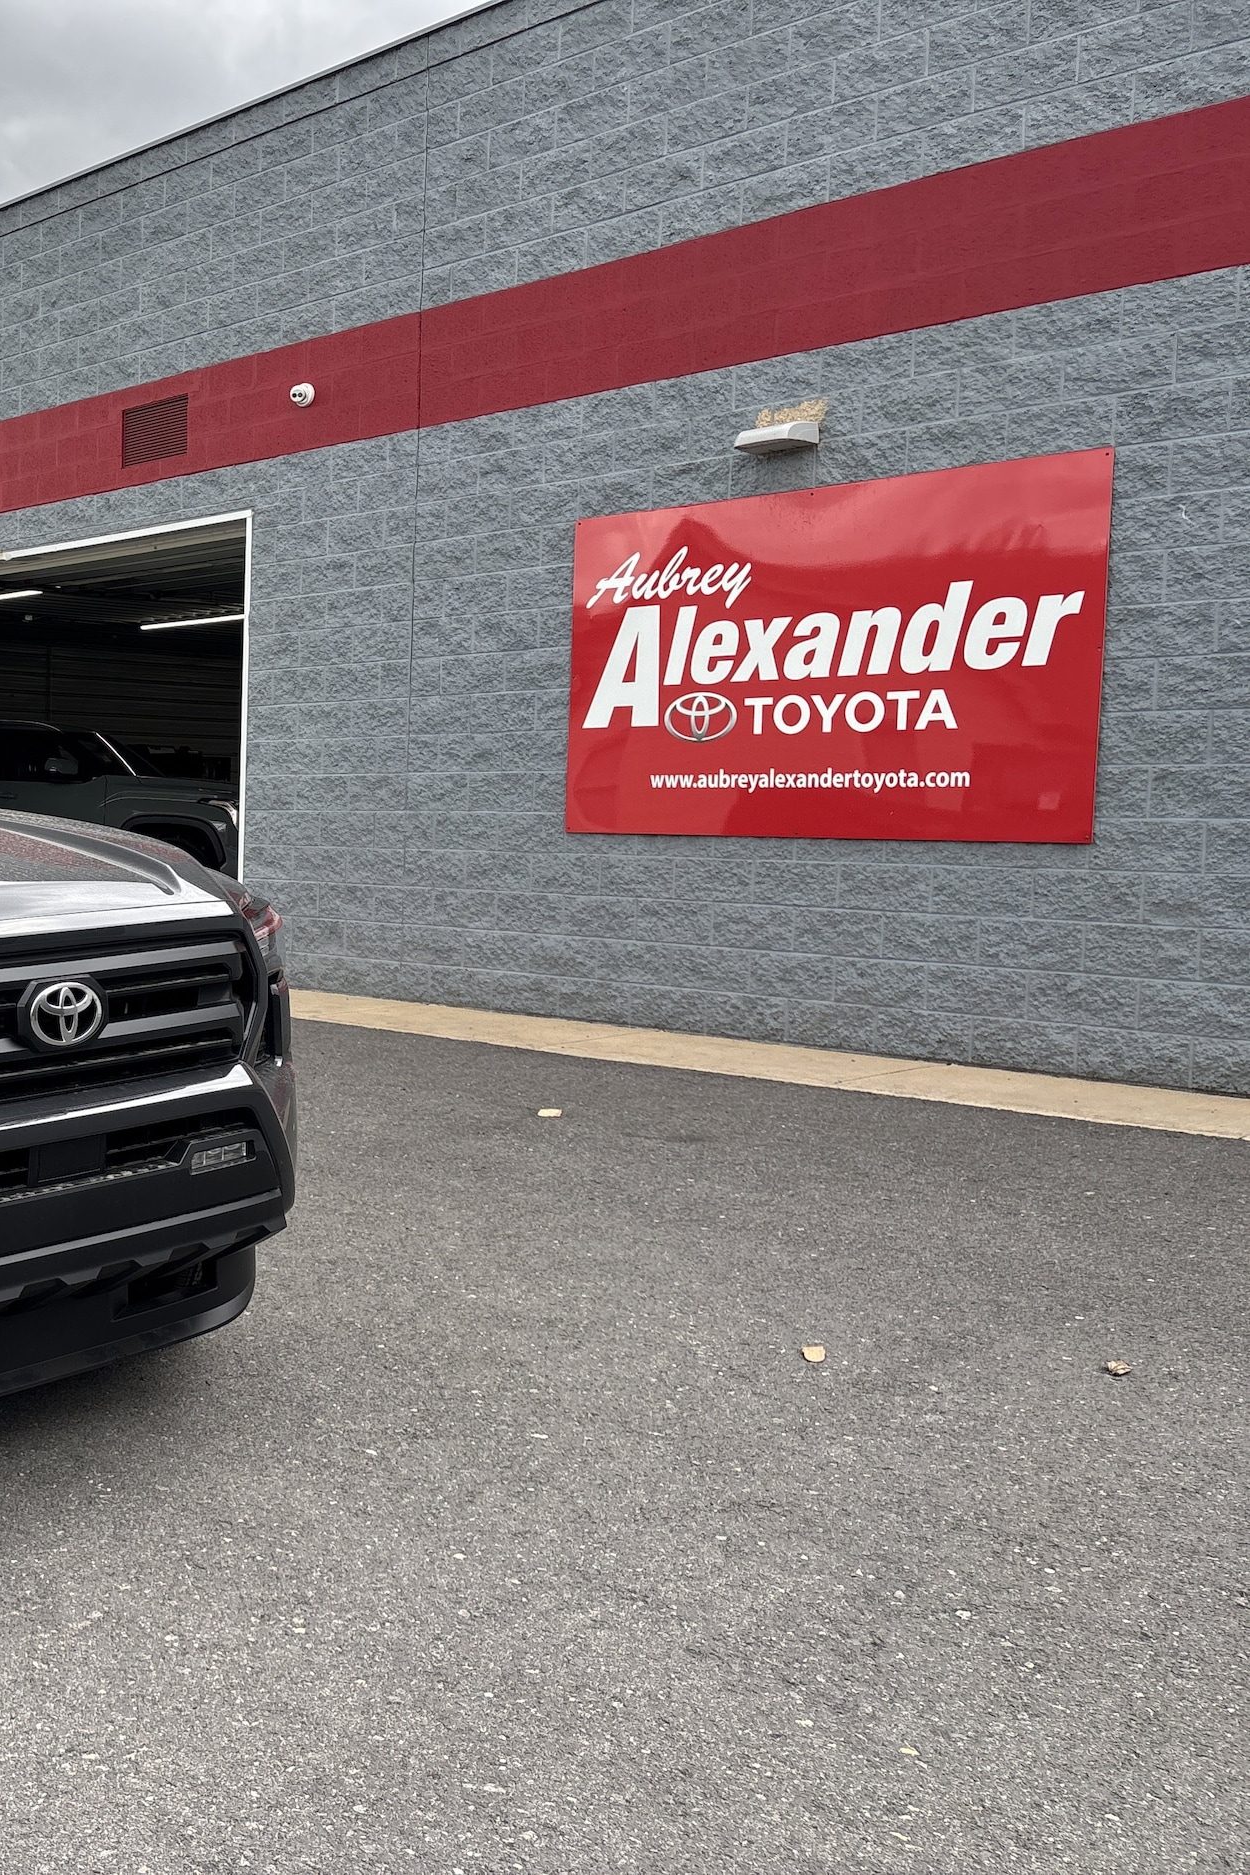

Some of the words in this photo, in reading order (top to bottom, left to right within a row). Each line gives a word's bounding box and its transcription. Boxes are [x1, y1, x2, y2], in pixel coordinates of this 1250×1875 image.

[586, 546, 752, 609] Aubrey
[582, 580, 1085, 729] Alexander
[744, 688, 959, 735] TOYOTA
[650, 767, 971, 793] www.aubreyalexandertoyota.com
